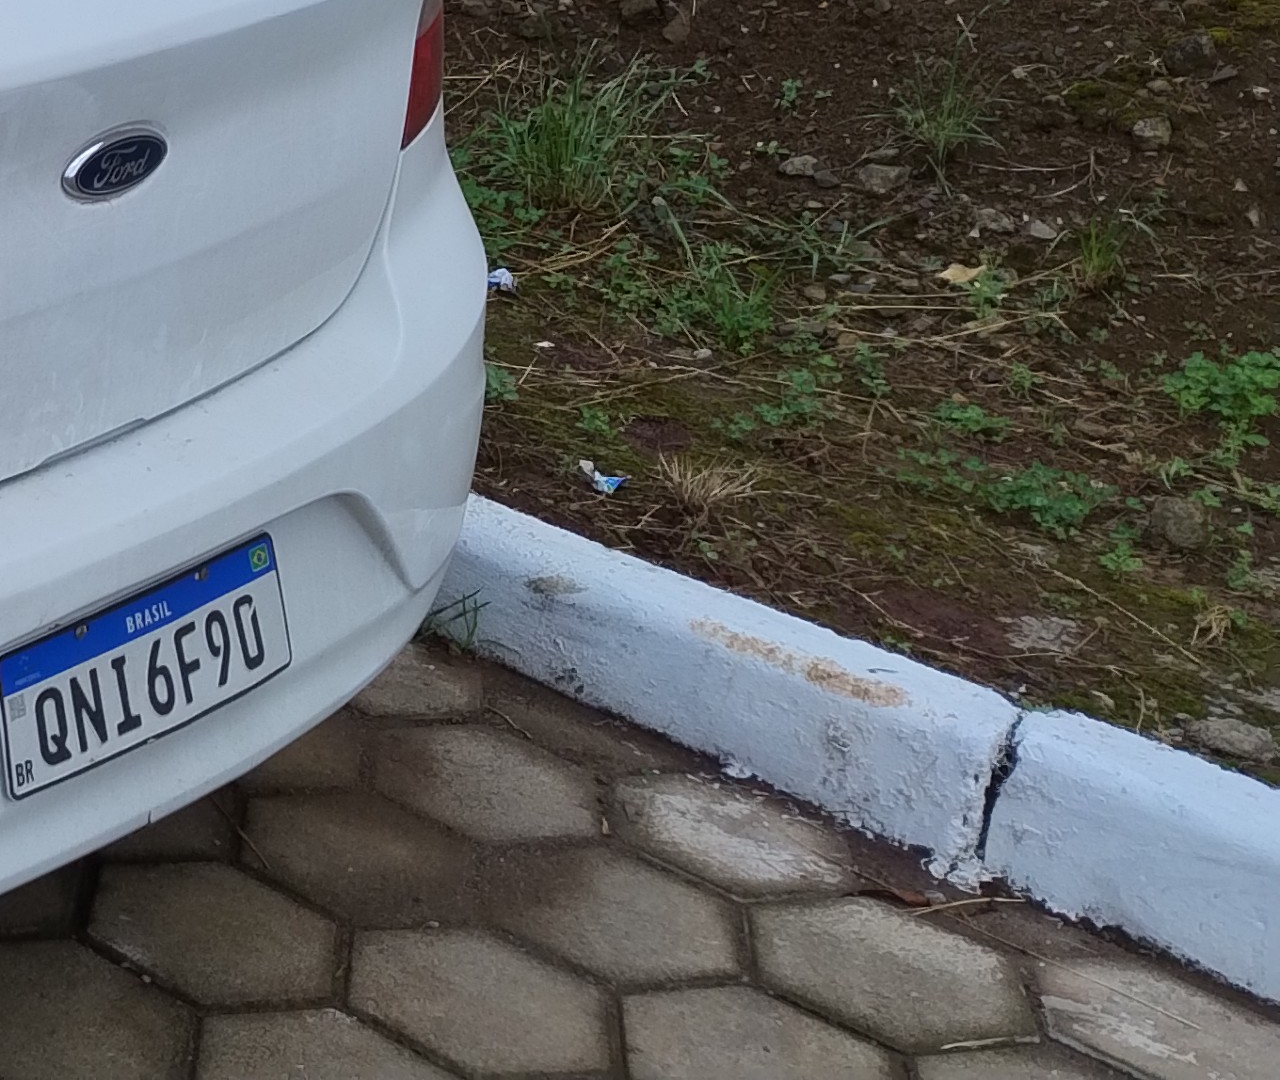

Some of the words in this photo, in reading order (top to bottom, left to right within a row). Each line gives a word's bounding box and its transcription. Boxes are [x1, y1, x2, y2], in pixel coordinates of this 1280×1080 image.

[94, 145, 150, 188] Ford
[125, 600, 172, 634] BRASIL
[34, 594, 265, 766] QNI6F90
[15, 760, 35, 787] BR
